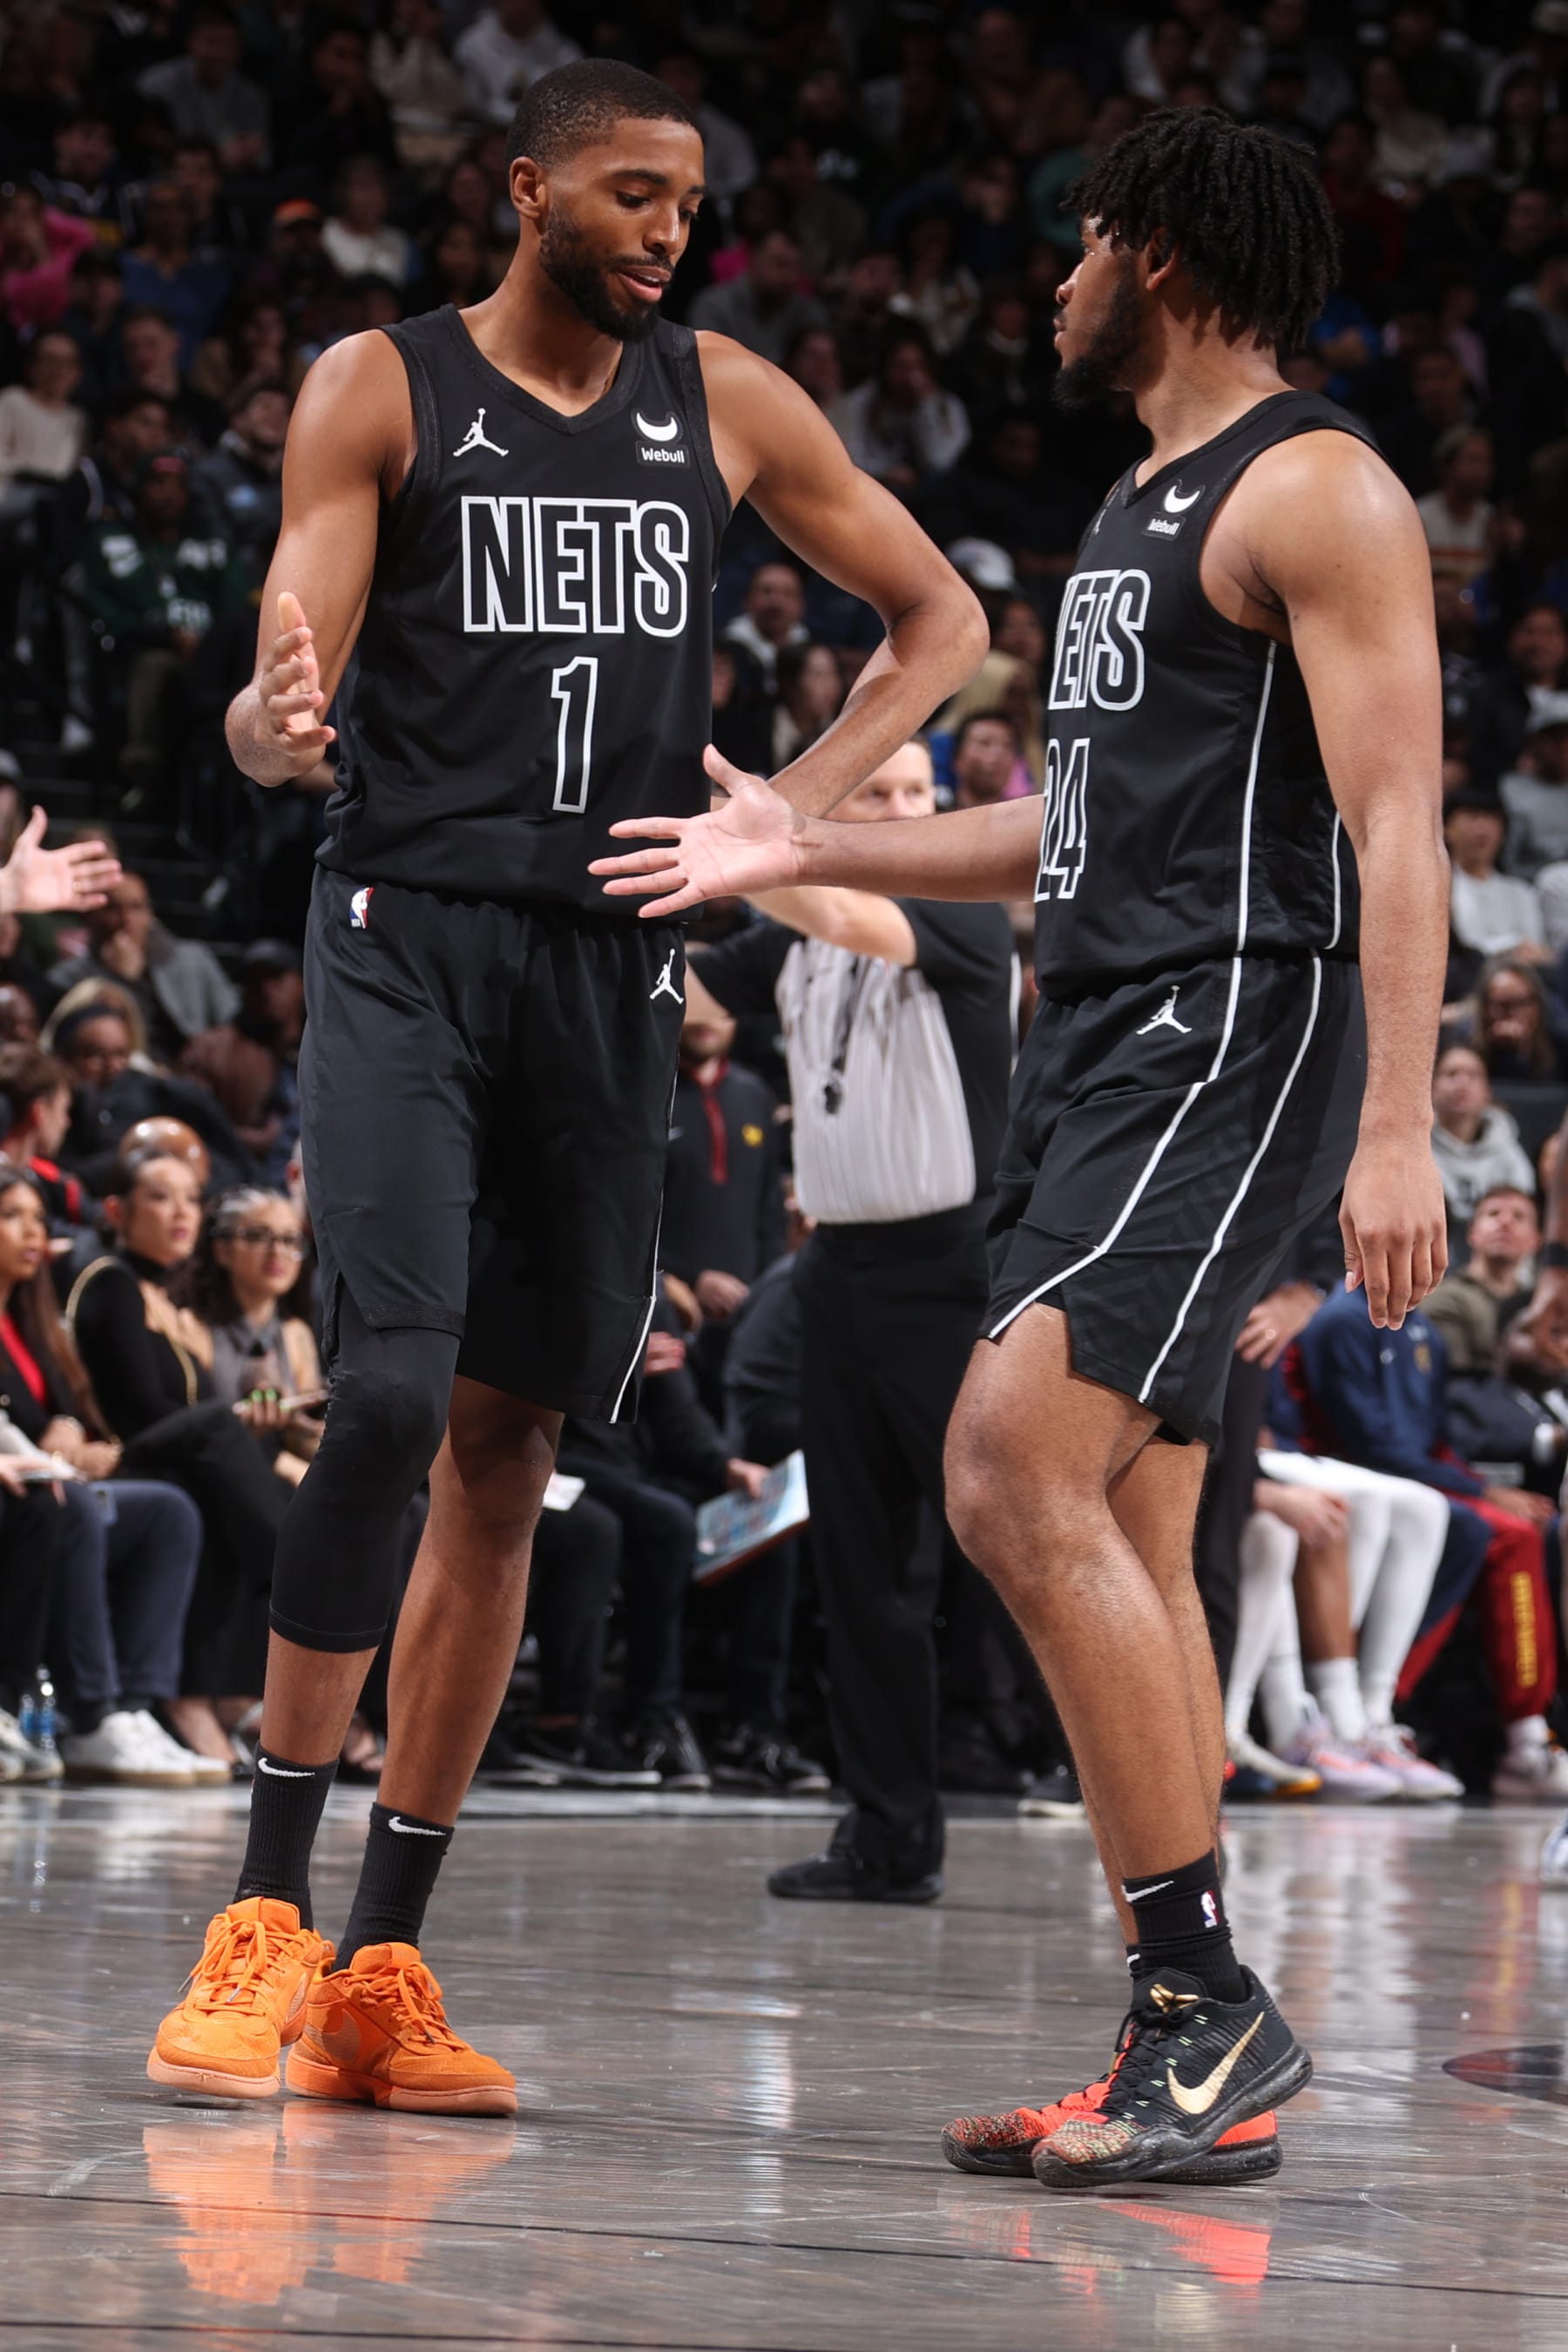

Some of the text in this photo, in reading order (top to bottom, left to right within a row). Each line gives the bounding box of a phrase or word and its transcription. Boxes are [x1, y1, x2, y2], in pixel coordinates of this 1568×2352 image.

[641, 447, 685, 463] Webull
[461, 496, 689, 638] NETS
[1048, 569, 1151, 712] ETS
[551, 656, 598, 814] 1
